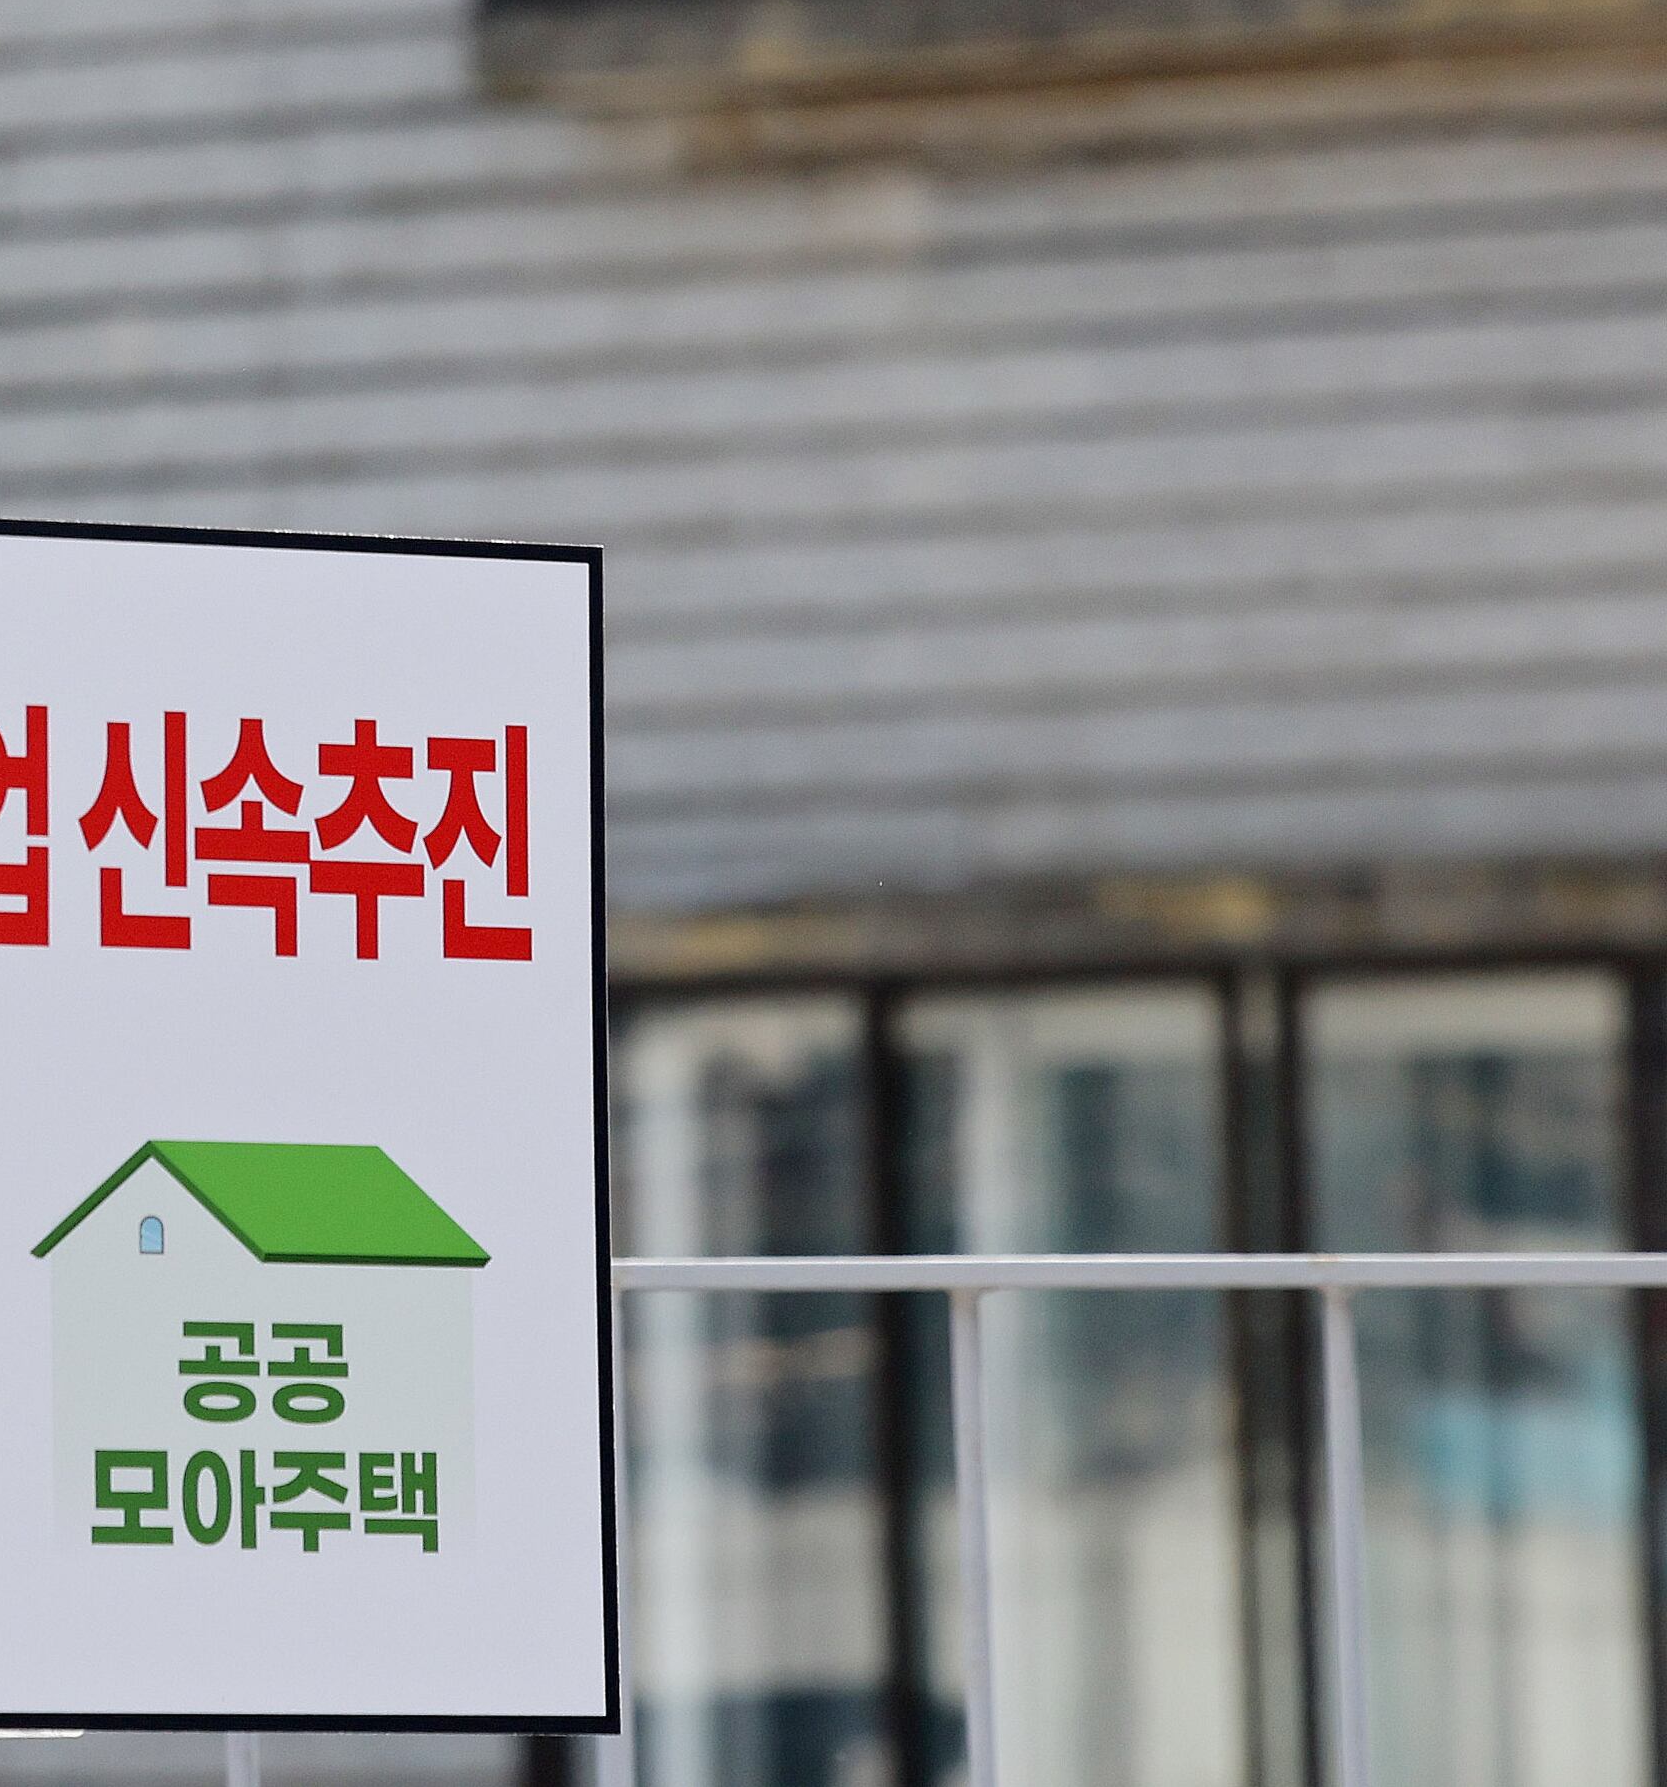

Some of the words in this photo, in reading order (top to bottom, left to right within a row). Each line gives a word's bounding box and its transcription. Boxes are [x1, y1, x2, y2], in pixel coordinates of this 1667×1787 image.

[78, 709, 534, 962] 신속추진
[181, 1322, 348, 1423] 공공
[92, 1450, 437, 1552] 모아주택
